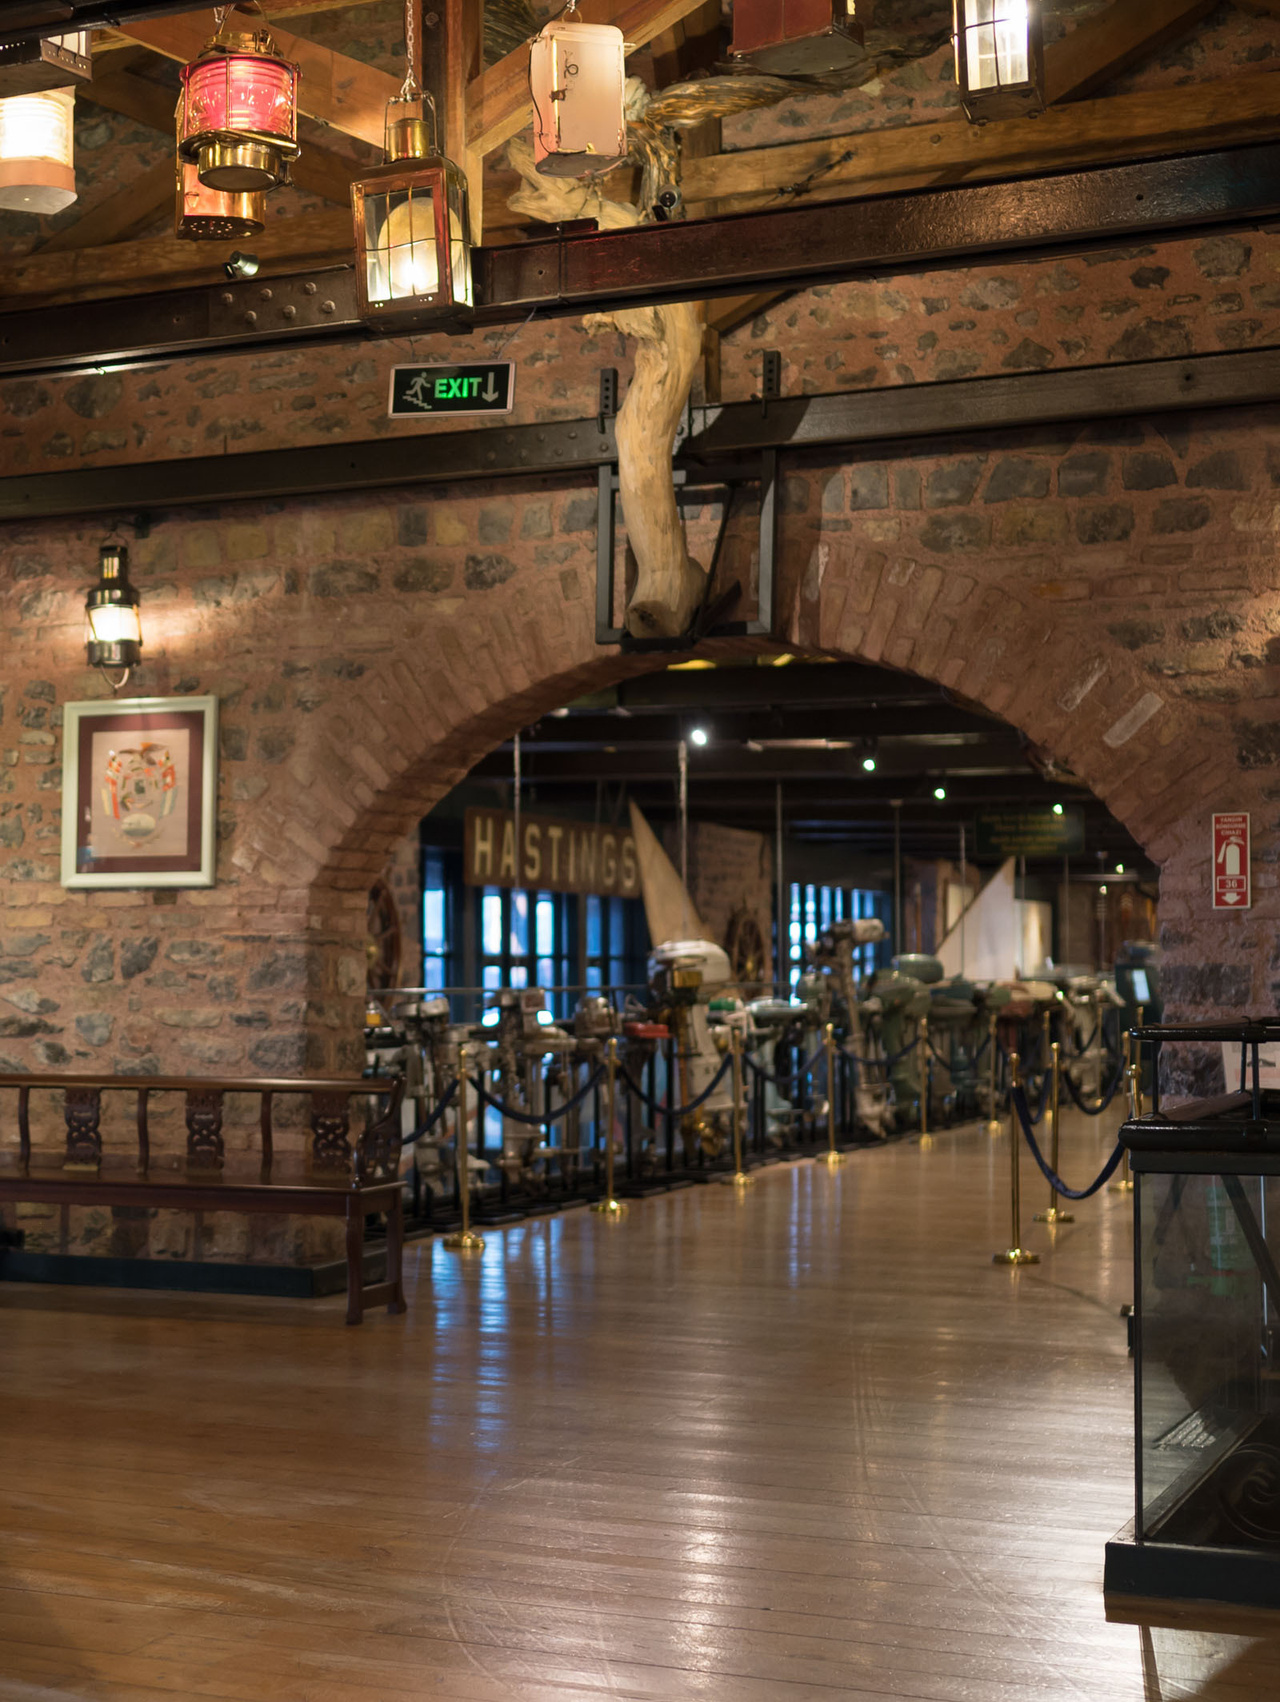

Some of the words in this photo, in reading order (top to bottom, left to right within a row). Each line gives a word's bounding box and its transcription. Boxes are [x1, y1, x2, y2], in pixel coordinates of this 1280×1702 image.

[434, 377, 482, 398] EXIT
[474, 816, 636, 889] HASTINGS
[1225, 881, 1238, 889] 36
